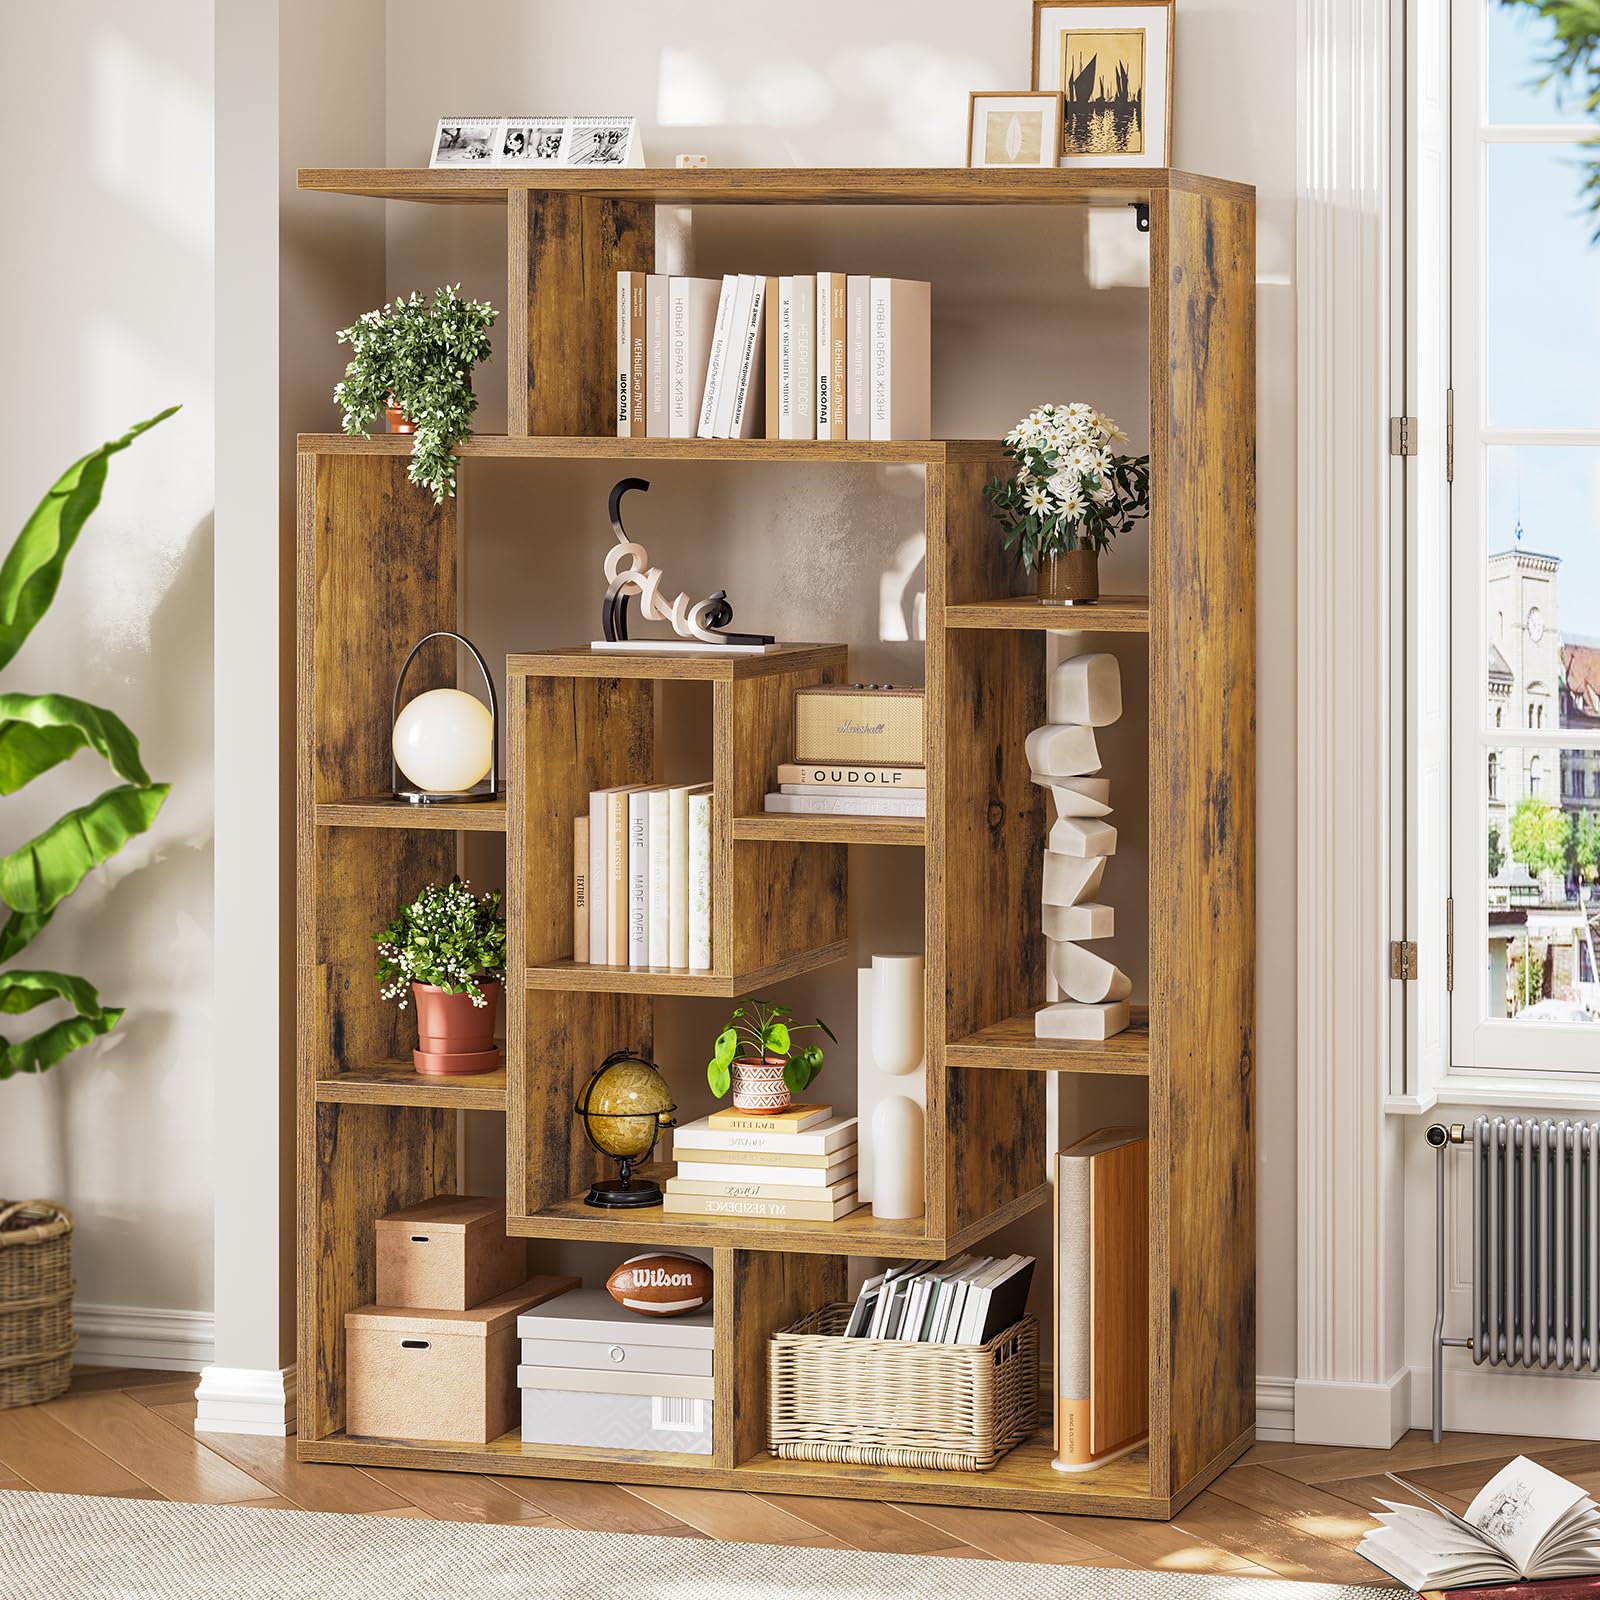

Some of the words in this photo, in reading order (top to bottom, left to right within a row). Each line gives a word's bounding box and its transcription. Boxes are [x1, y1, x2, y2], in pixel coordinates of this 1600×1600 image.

[674, 297, 685, 338] НОВЫЙ
[799, 323, 808, 337] НЕ
[876, 299, 886, 339] НОВЫЙ
[674, 340, 684, 375] ОБРАЗ
[745, 332, 755, 361] Религия
[799, 338, 808, 365] БЕРИ
[876, 341, 885, 377] ОБРАЗ
[740, 361, 750, 387] черной
[799, 367, 808, 375] В
[619, 373, 627, 422] ШОКОЛАД
[633, 391, 642, 423] ЛУЧШЕ
[674, 378, 684, 418] ЖИЗНИ
[704, 395, 714, 425] ВОСТОКА
[734, 387, 745, 424] водолазки
[799, 376, 808, 416] ГОЛОВУ
[820, 375, 828, 424] ШОКОЛАД
[834, 393, 843, 425] ЛУЧШЕ
[876, 379, 885, 420] ЖИЗНИ
[837, 719, 885, 735] Marshall
[814, 770, 902, 783] OUDOLF
[632, 818, 643, 848] HOME
[632, 875, 643, 903] MADE
[632, 908, 643, 943] LOVELY
[632, 1268, 693, 1288] Wilson
